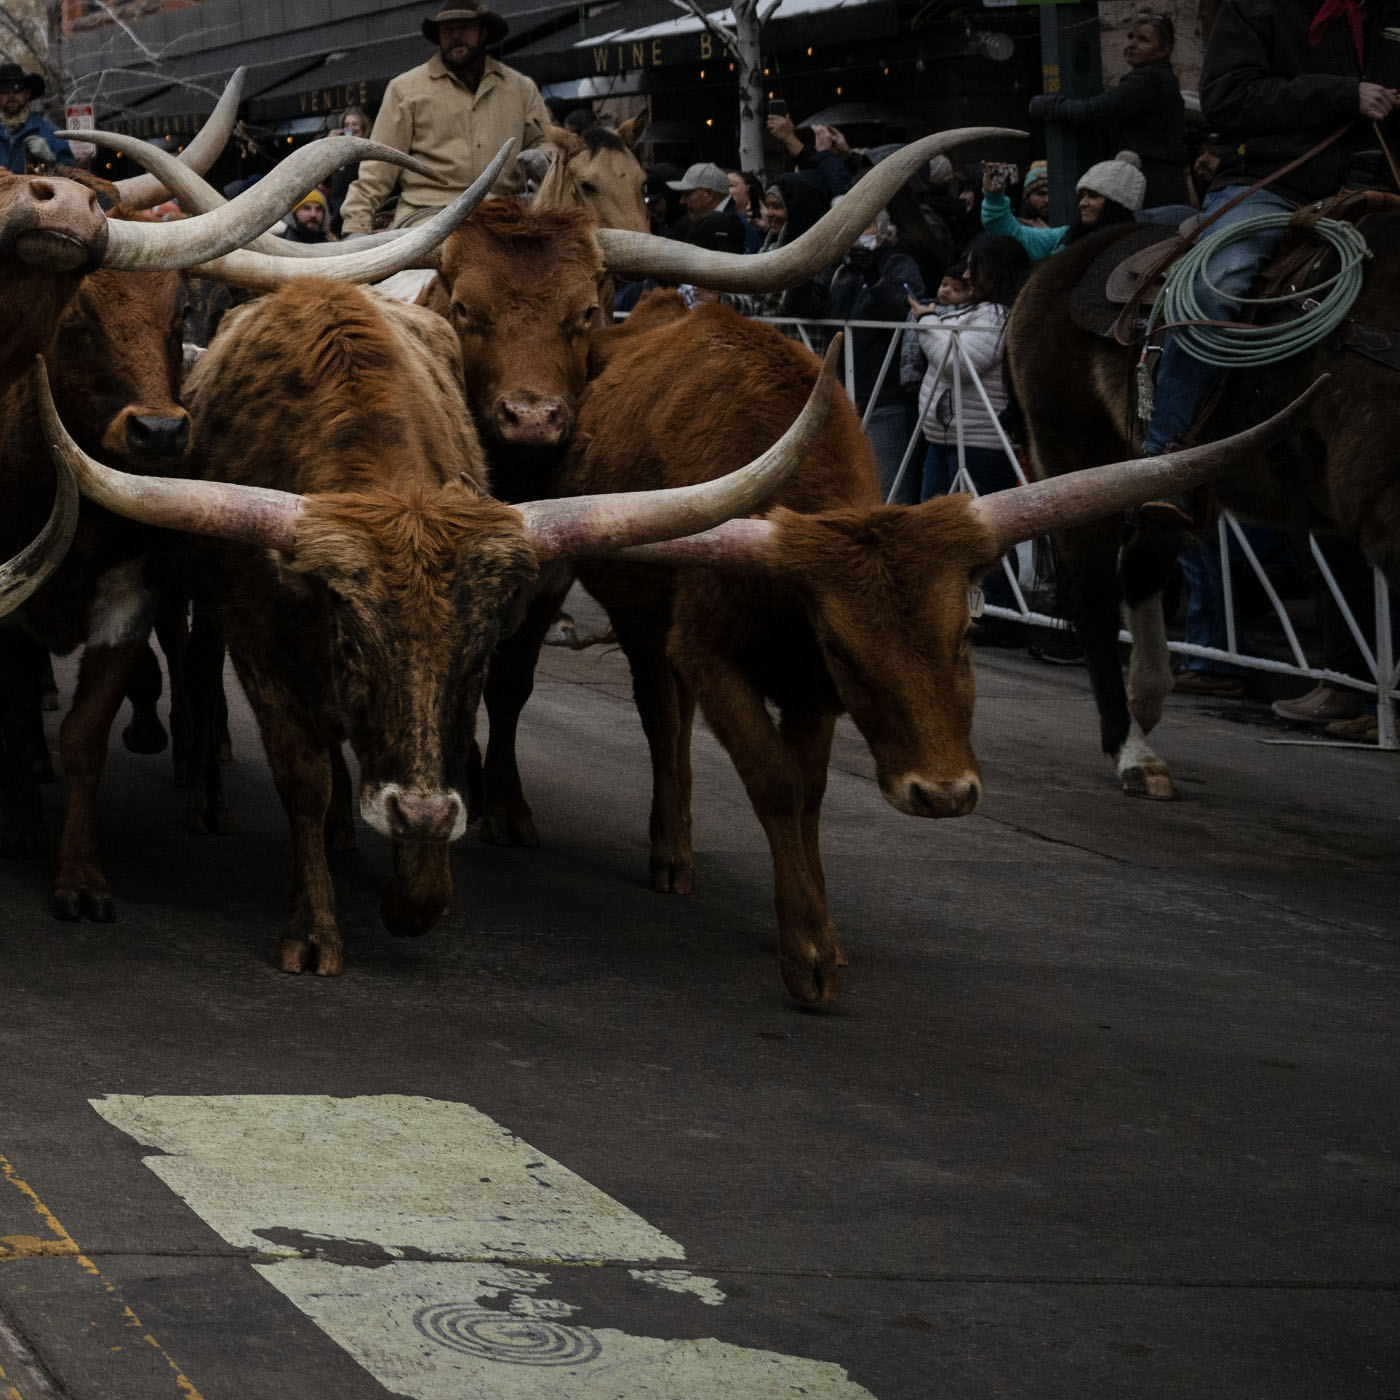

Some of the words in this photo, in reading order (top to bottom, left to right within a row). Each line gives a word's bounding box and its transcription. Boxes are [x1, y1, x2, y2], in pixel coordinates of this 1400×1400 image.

[592, 37, 664, 73] WINE
[297, 80, 369, 112] VENICE
[969, 590, 982, 610] 17
